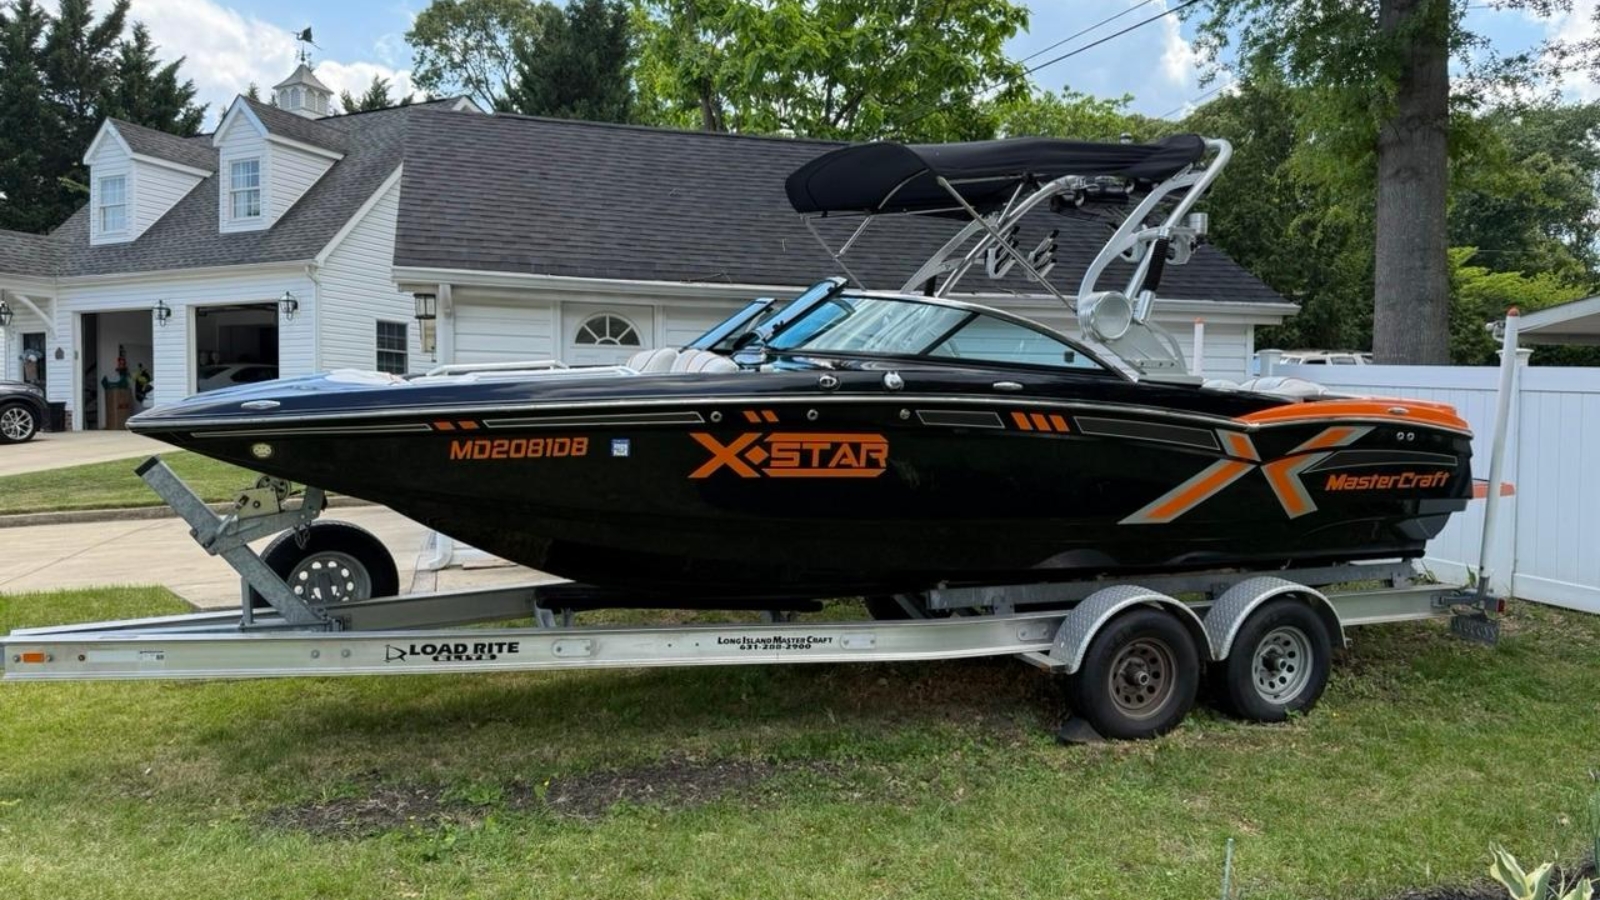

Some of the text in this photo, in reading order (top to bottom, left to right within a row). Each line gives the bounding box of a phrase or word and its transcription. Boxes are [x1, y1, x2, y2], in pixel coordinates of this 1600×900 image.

[450, 437, 588, 460] MD2081DB
[1325, 471, 1450, 491] MasterCraft
[409, 642, 519, 655] LOAD RITE
